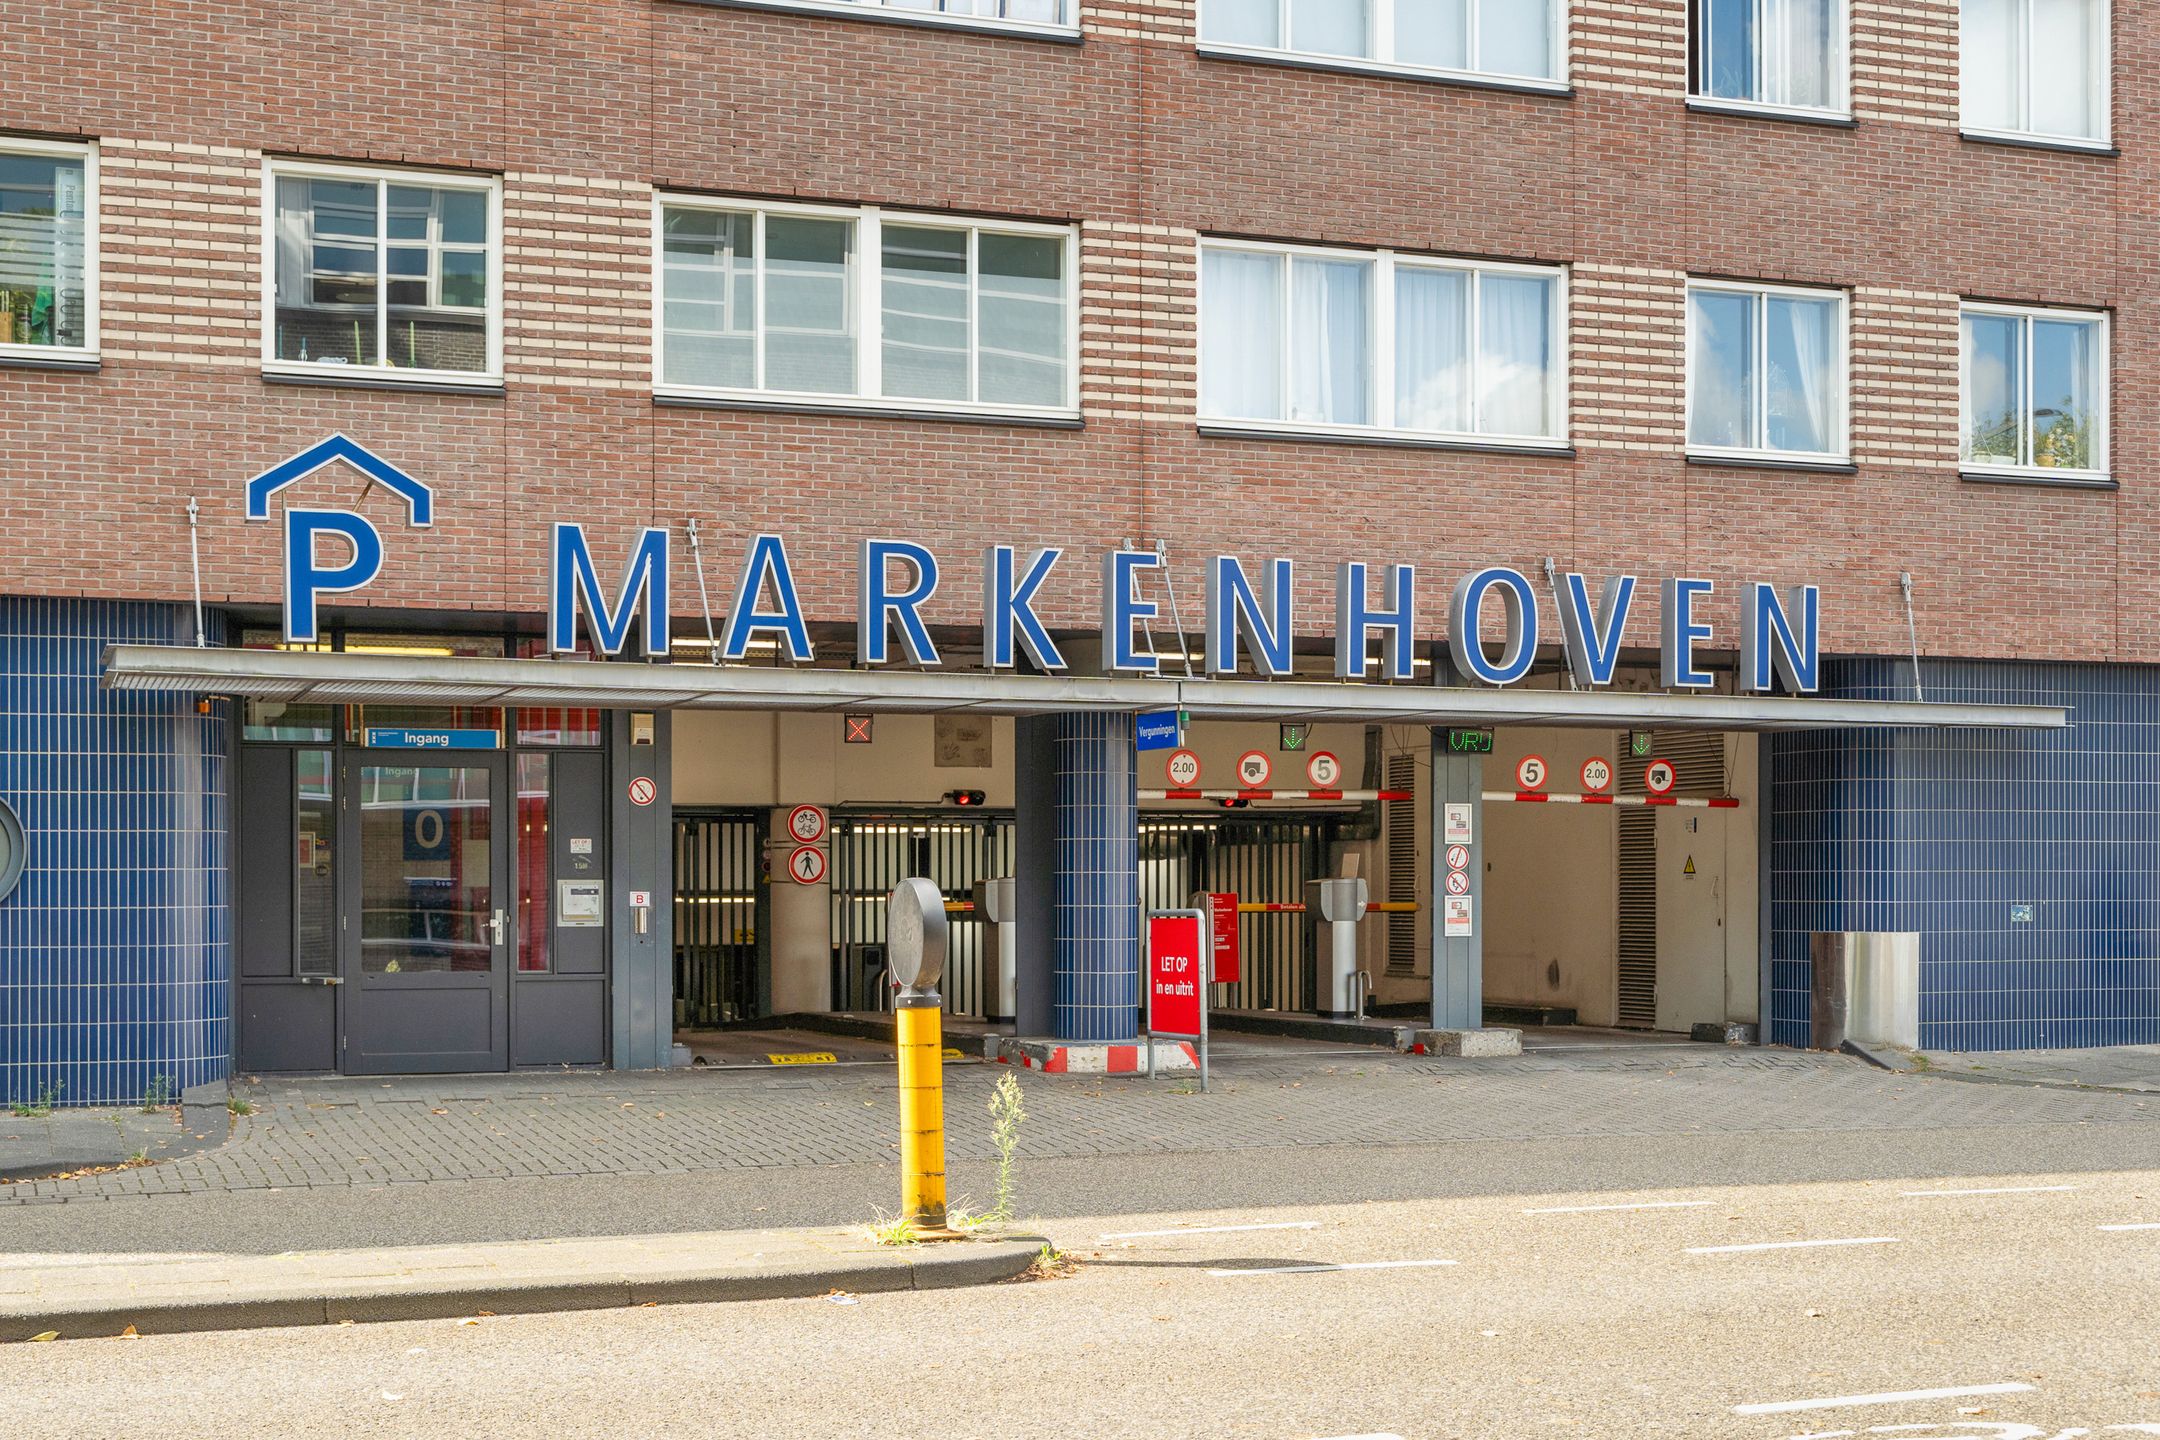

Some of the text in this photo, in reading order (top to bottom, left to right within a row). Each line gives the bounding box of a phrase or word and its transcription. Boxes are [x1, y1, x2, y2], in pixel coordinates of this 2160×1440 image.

[282, 507, 385, 643] P
[548, 521, 1821, 695] MARKENHOVEN
[404, 731, 450, 747] Ingang
[1138, 723, 1176, 740] Vergunningen
[1172, 761, 1195, 774] 2.00
[1317, 759, 1331, 781] 5
[1525, 762, 1539, 783] 5
[1586, 768, 1607, 780] 2.00
[636, 894, 644, 904] B
[1161, 956, 1188, 973] LET OP
[1156, 979, 1194, 996] in en uitrit
